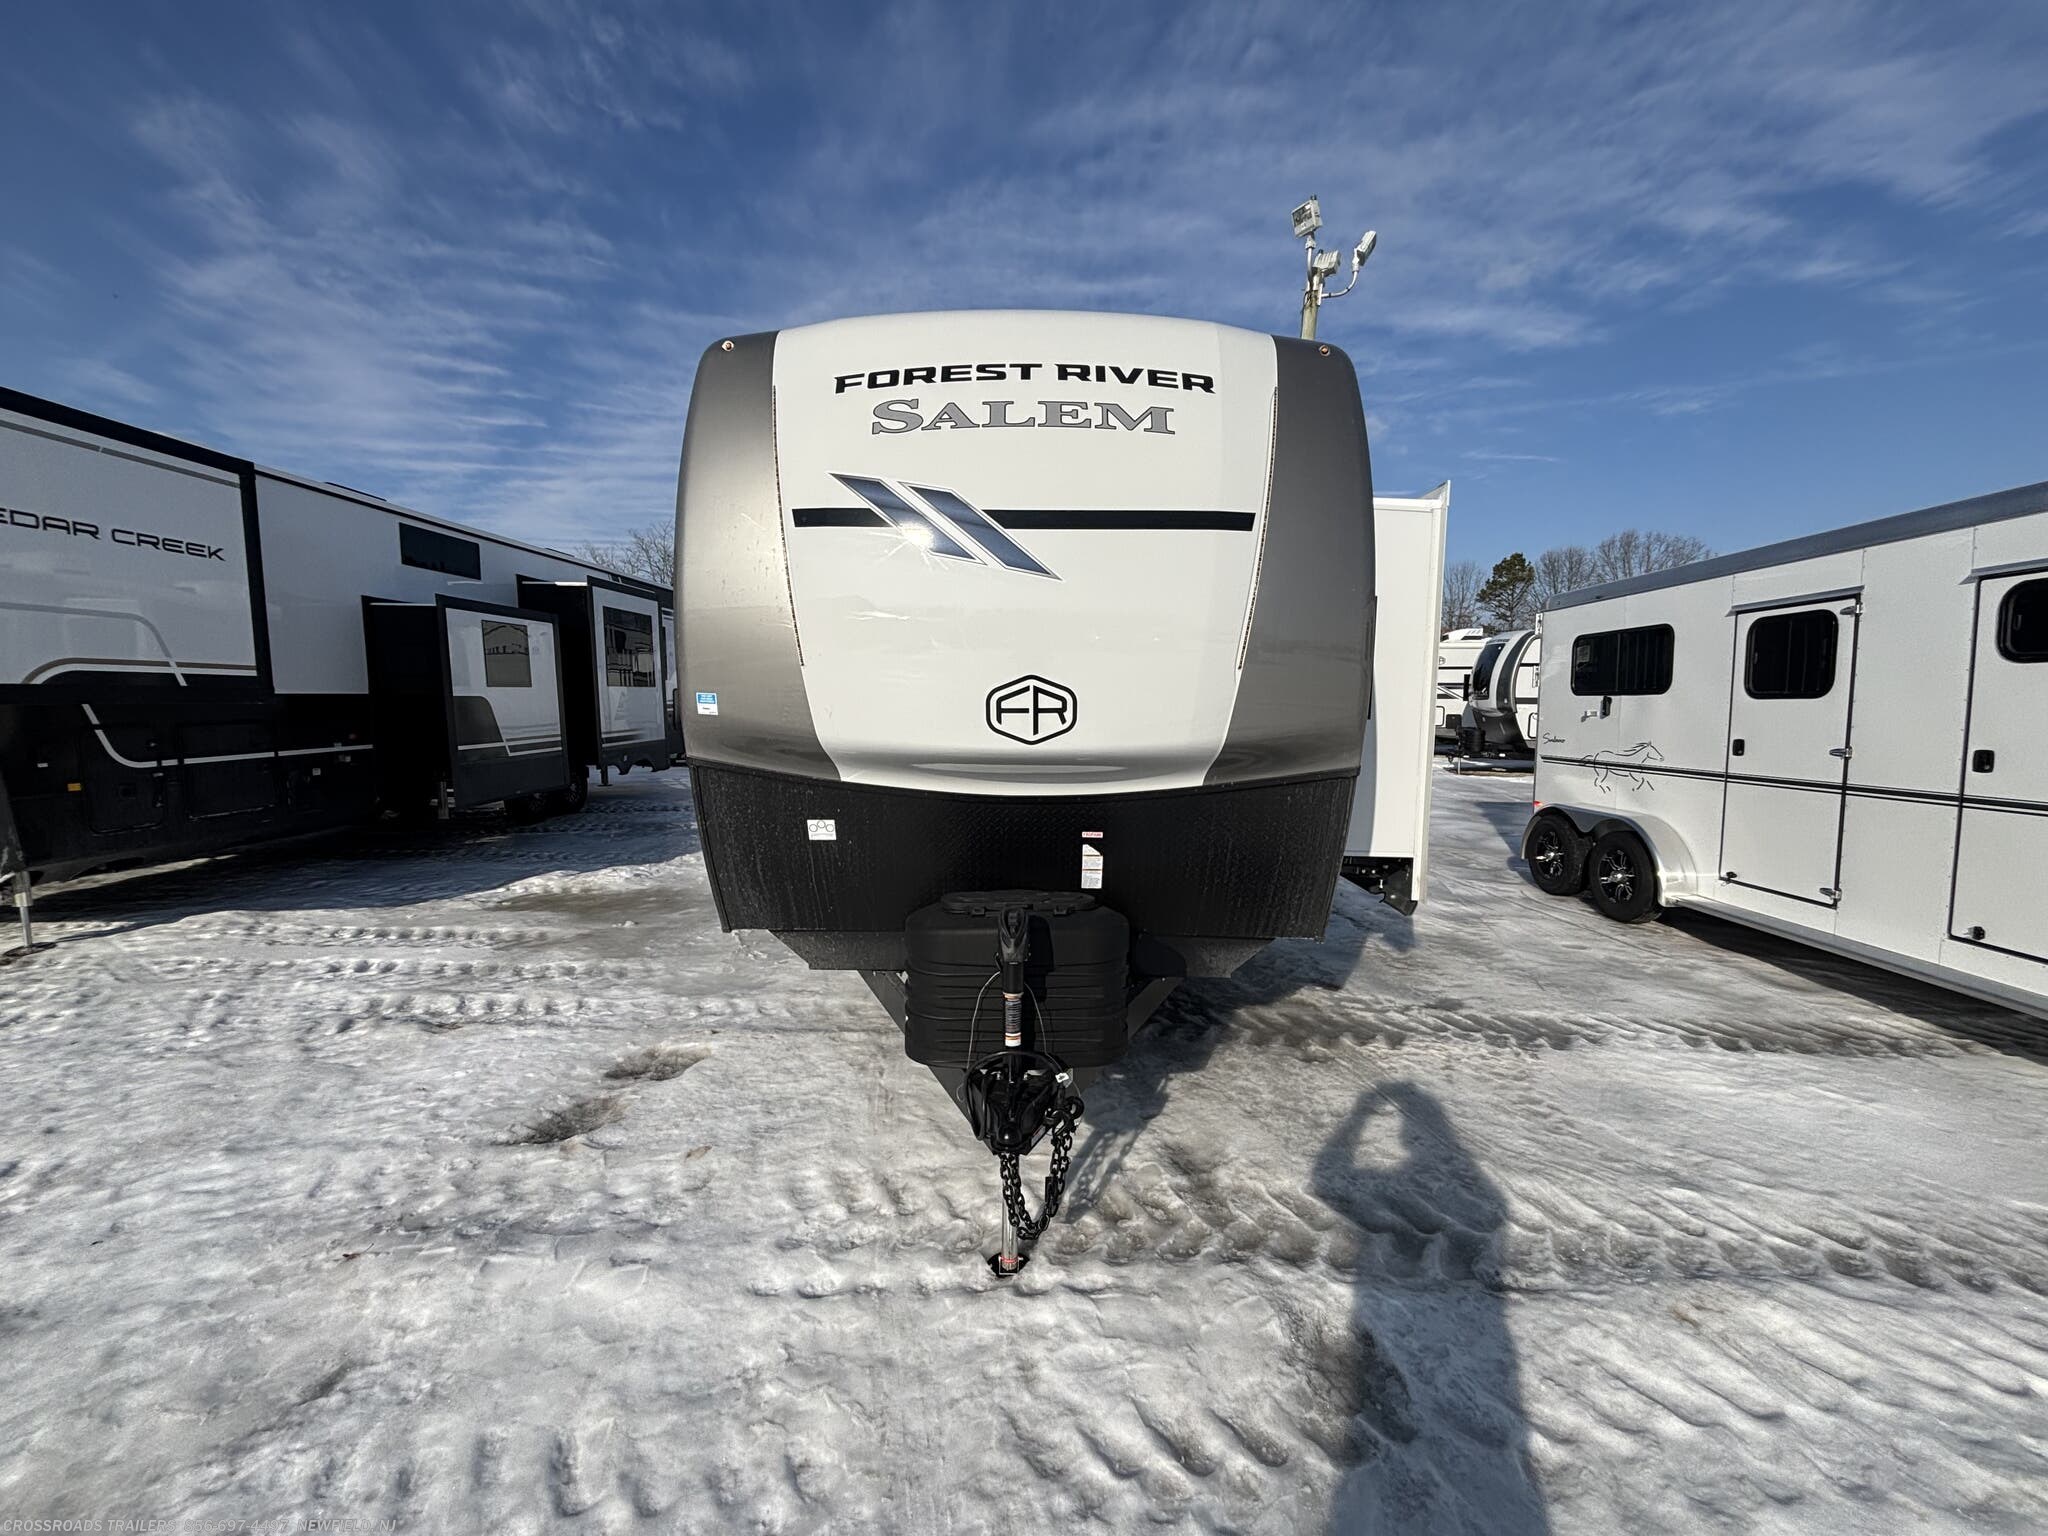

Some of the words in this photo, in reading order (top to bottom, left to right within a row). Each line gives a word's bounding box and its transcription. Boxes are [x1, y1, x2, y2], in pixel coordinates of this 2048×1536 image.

[835, 363, 1042, 393] FOREST
[1054, 363, 1216, 394] RIVER
[871, 398, 1176, 435] SALEM
[111, 528, 226, 562] CREEK
